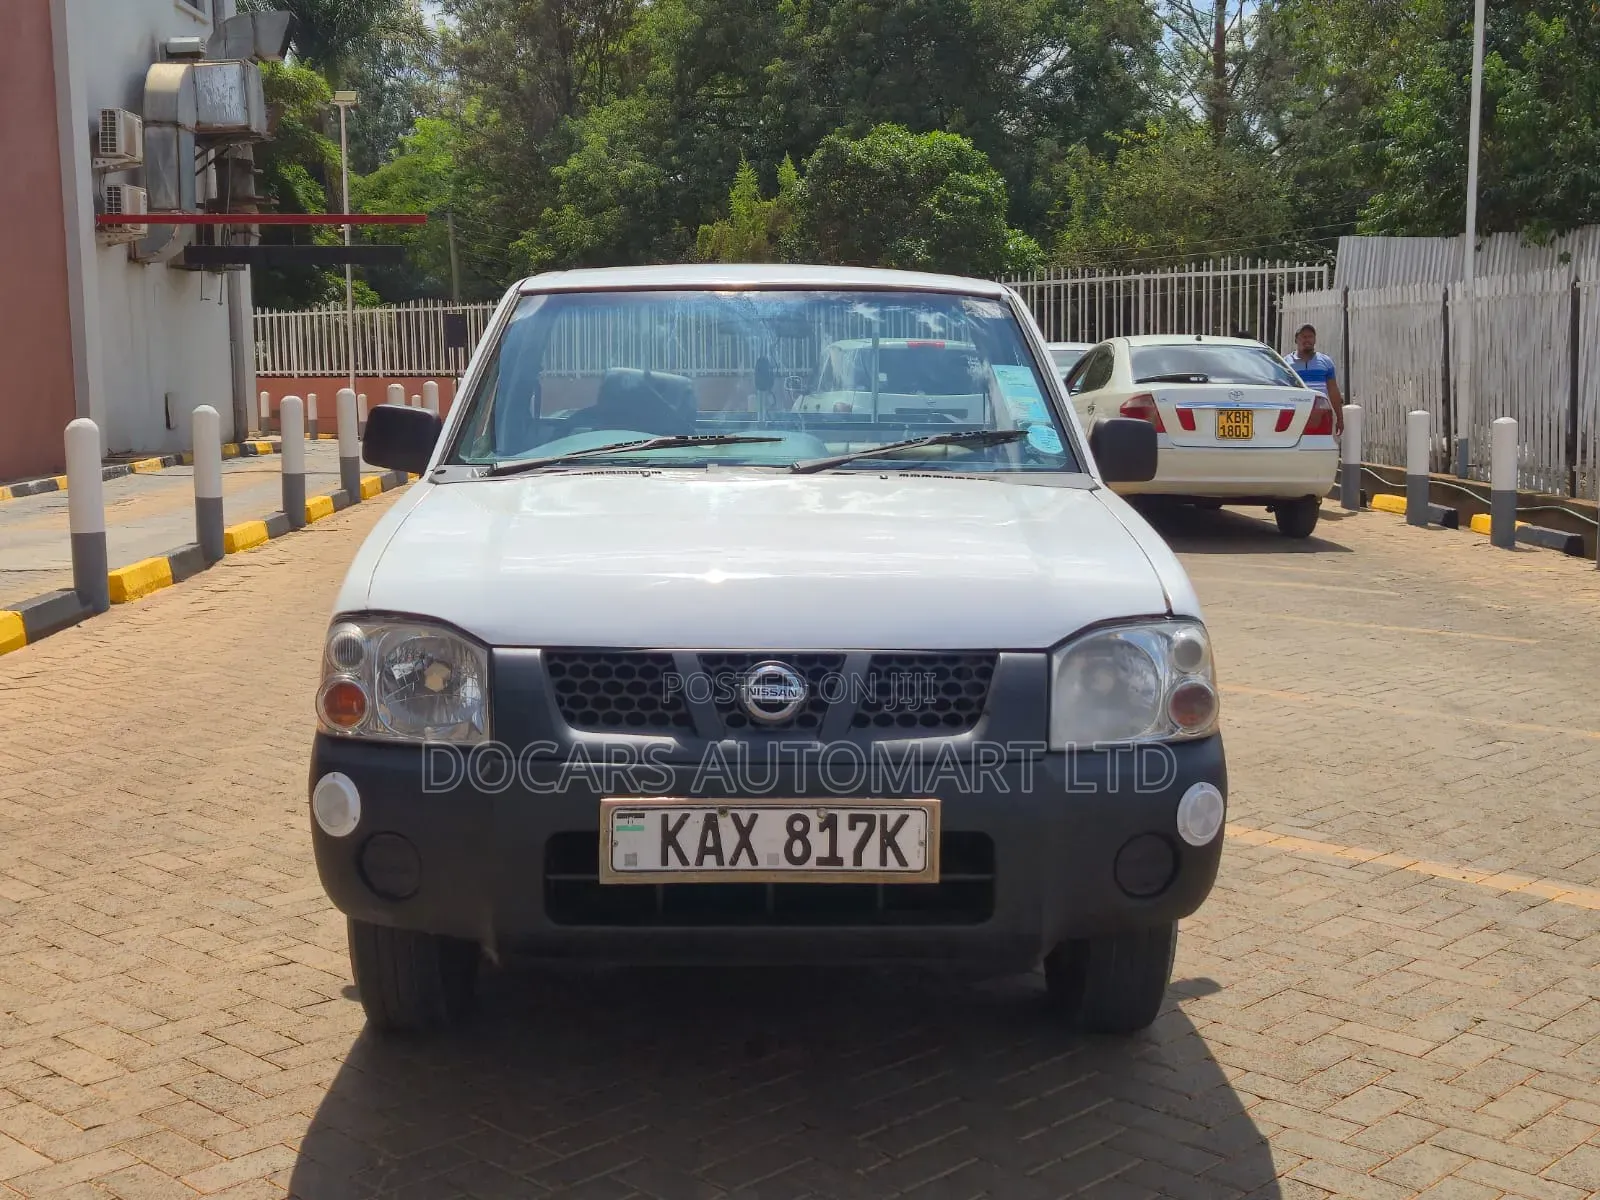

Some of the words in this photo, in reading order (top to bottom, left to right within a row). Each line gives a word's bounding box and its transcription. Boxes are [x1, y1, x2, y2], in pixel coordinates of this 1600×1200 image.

[1226, 411, 1250, 424] KBH
[747, 687, 798, 698] NISSAN
[660, 812, 759, 867] KAX
[783, 812, 911, 867] 817K
